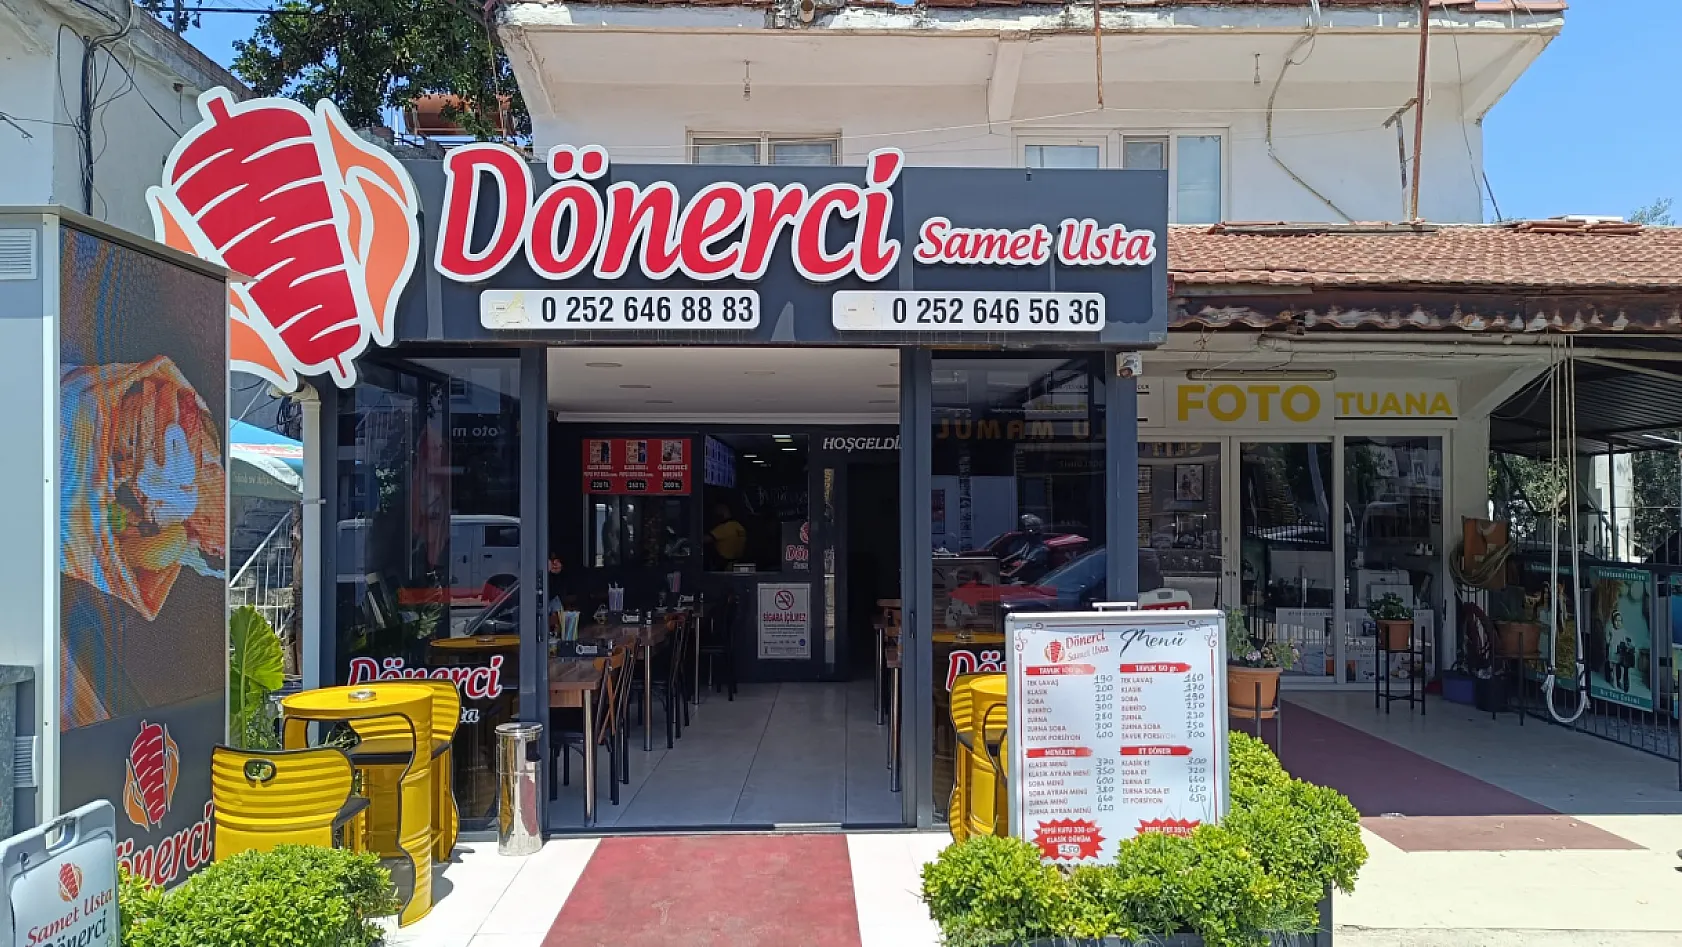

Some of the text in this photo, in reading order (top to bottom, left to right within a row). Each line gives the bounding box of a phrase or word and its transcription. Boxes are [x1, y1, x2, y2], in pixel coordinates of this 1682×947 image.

[437, 145, 900, 279] Dönerci
[915, 219, 1154, 263] Samet Usta
[541, 297, 754, 322] 0 252 646 88 83
[892, 298, 1099, 325] 0 252 646 56 36
[1177, 384, 1453, 422] FOTO TUANA
[1065, 629, 1105, 649] Dönerci
[1119, 628, 1187, 657] Menü
[25, 888, 112, 947] Samet Usta
[43, 910, 107, 947] önerci
